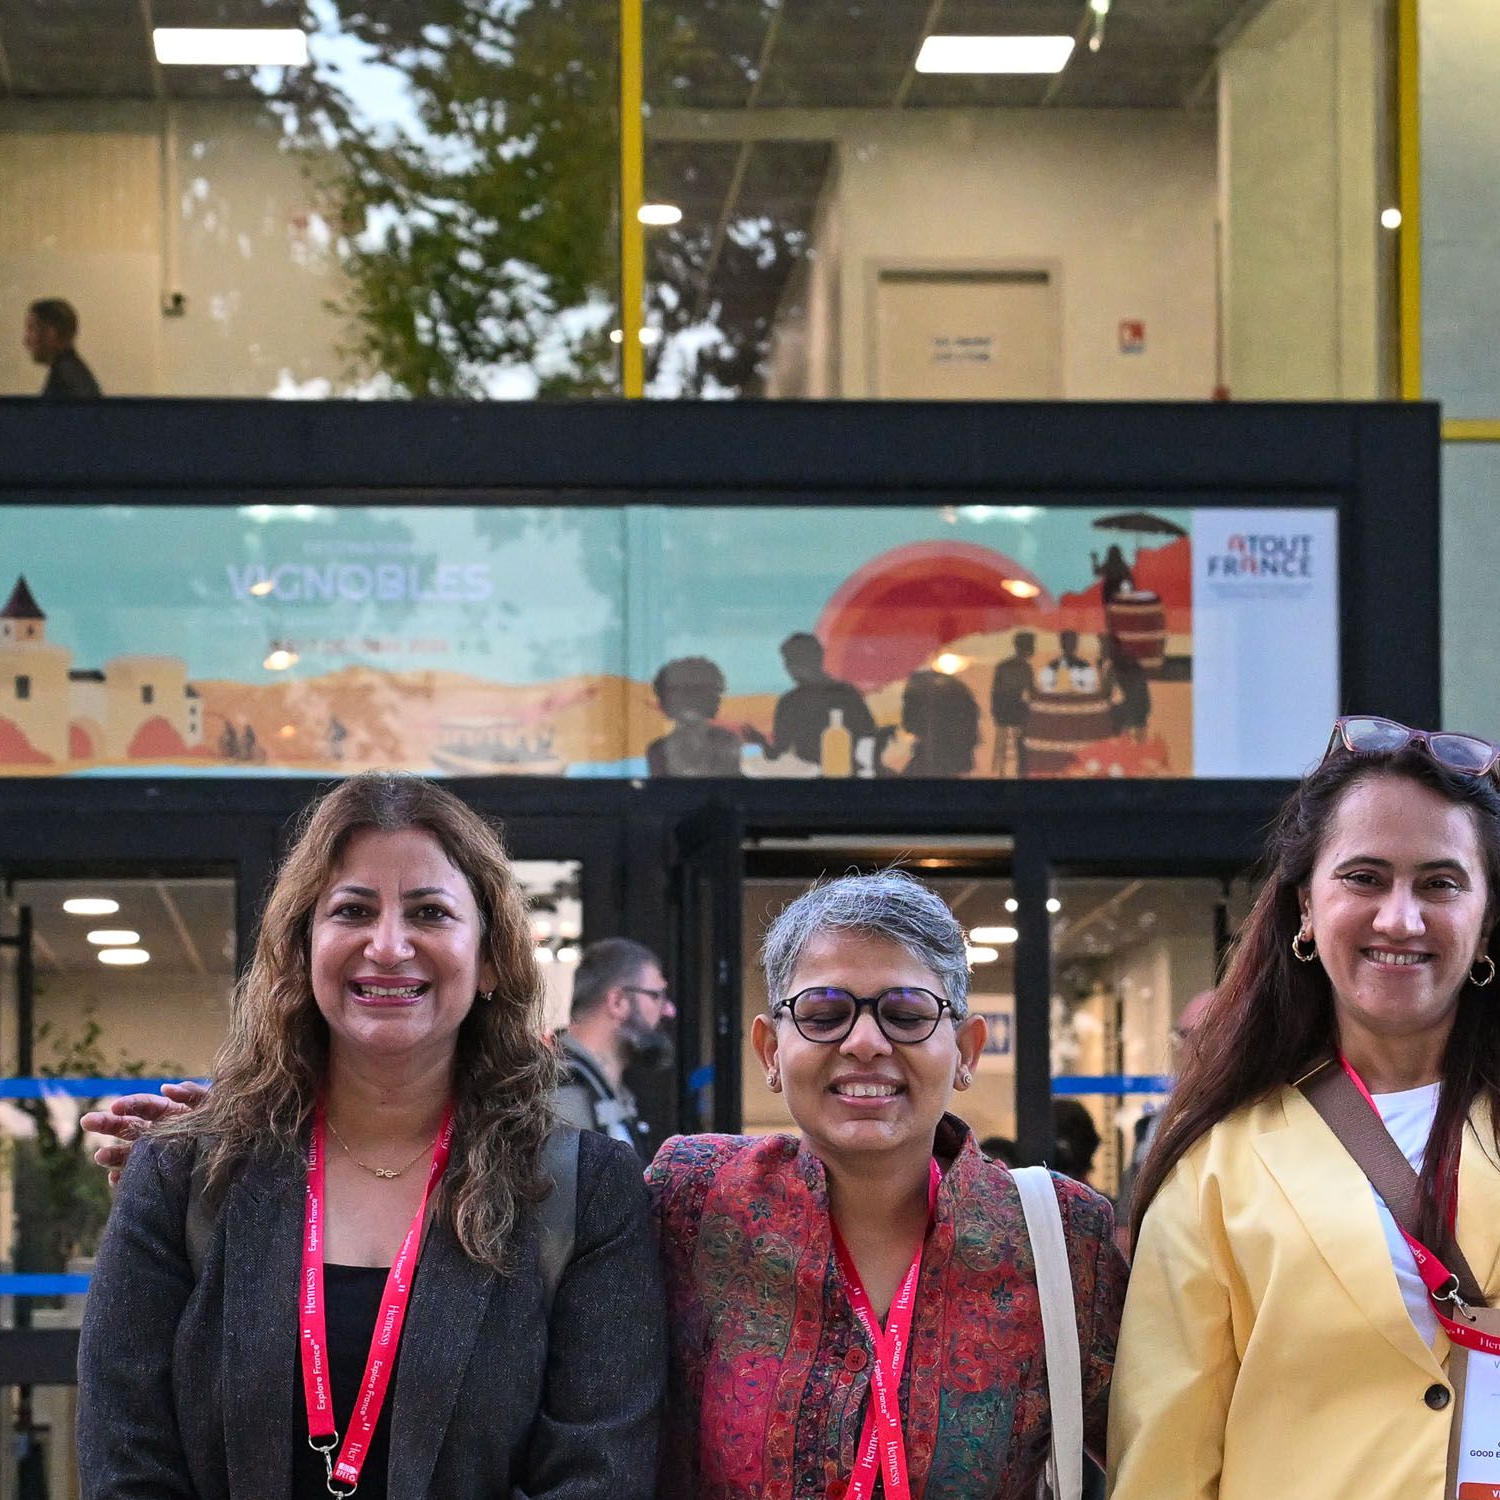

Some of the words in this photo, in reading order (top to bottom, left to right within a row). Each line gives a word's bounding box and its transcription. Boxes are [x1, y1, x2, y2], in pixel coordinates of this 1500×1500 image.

[1228, 534, 1313, 552] ATOUT
[1207, 555, 1313, 577] FRANCE
[308, 1222, 317, 1252] Explore
[304, 1266, 317, 1314] Hennessy
[896, 1263, 917, 1310] Hennessy
[378, 1304, 399, 1347] Hennessy
[369, 1360, 383, 1390] Explore
[316, 1376, 328, 1410] Explore
[861, 1424, 878, 1469] Hennes
[887, 1440, 900, 1487] Hennessy
[1470, 1450, 1494, 1458] GOOD
